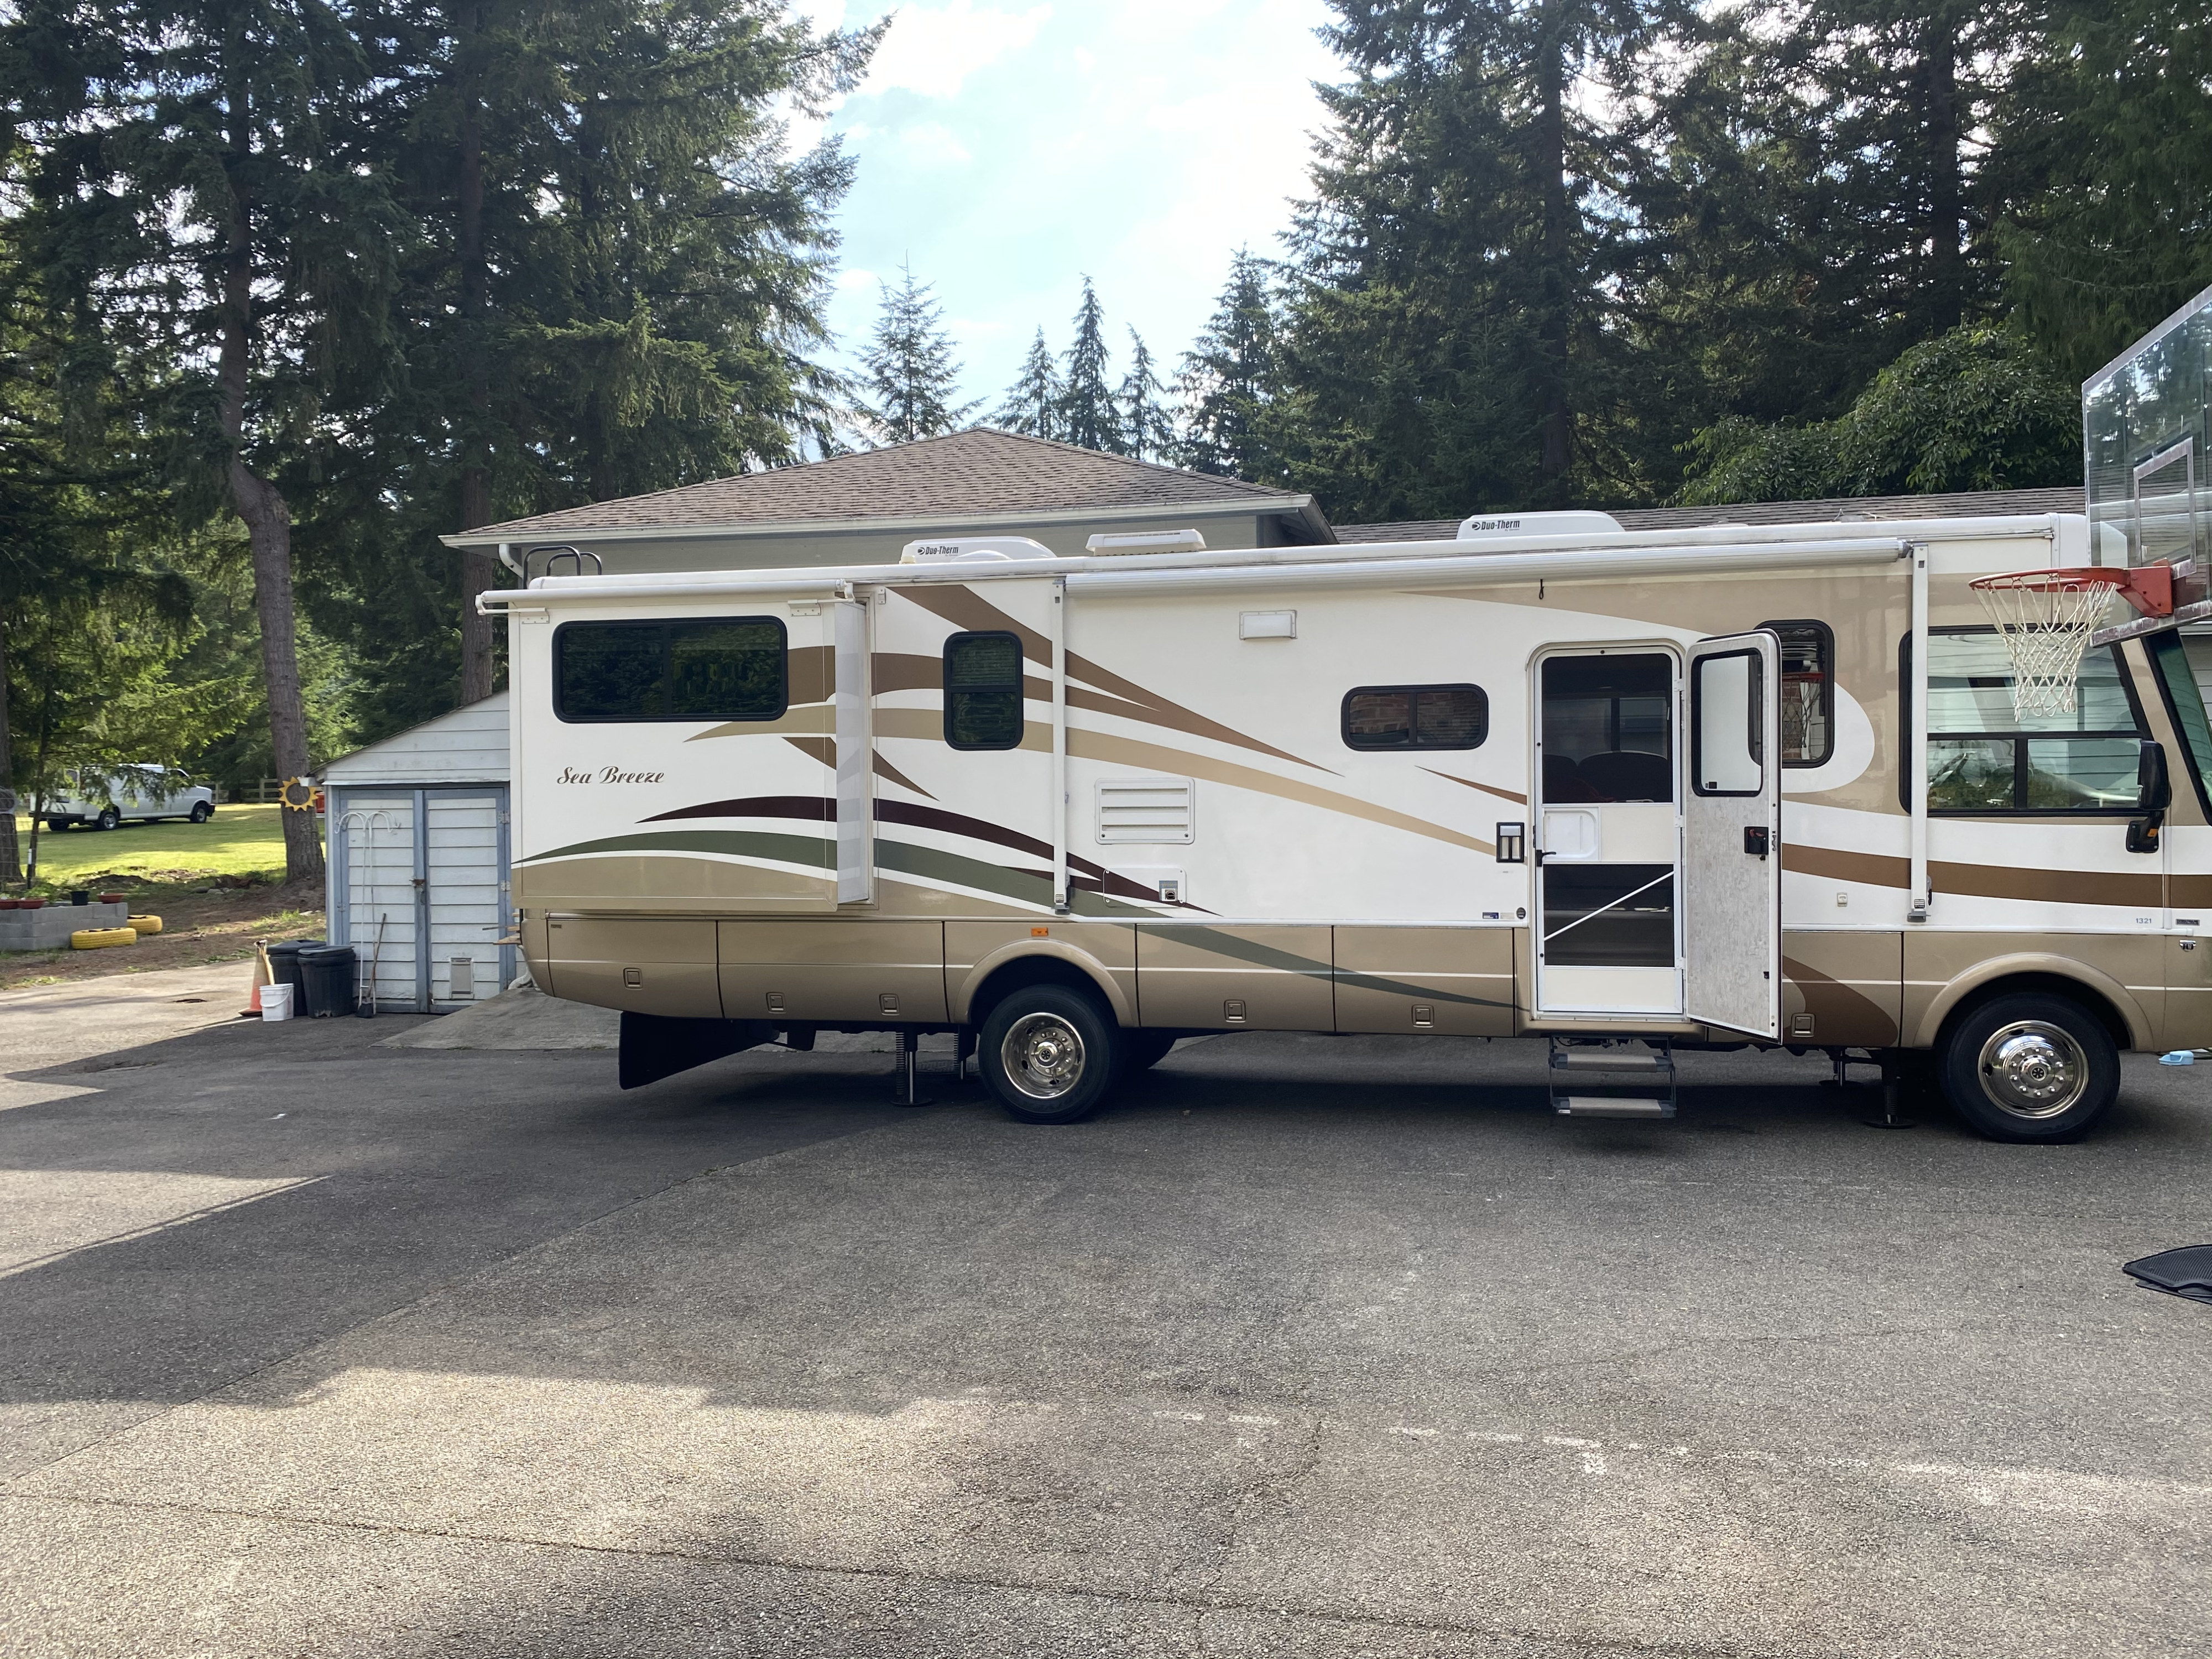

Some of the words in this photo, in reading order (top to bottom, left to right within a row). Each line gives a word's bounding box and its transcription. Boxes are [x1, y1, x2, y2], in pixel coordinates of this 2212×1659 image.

[1481, 520, 1520, 530] Duo-Therm
[925, 546, 959, 555] Duo-Therm
[556, 766, 592, 785] Sea
[598, 766, 665, 784] Breeze
